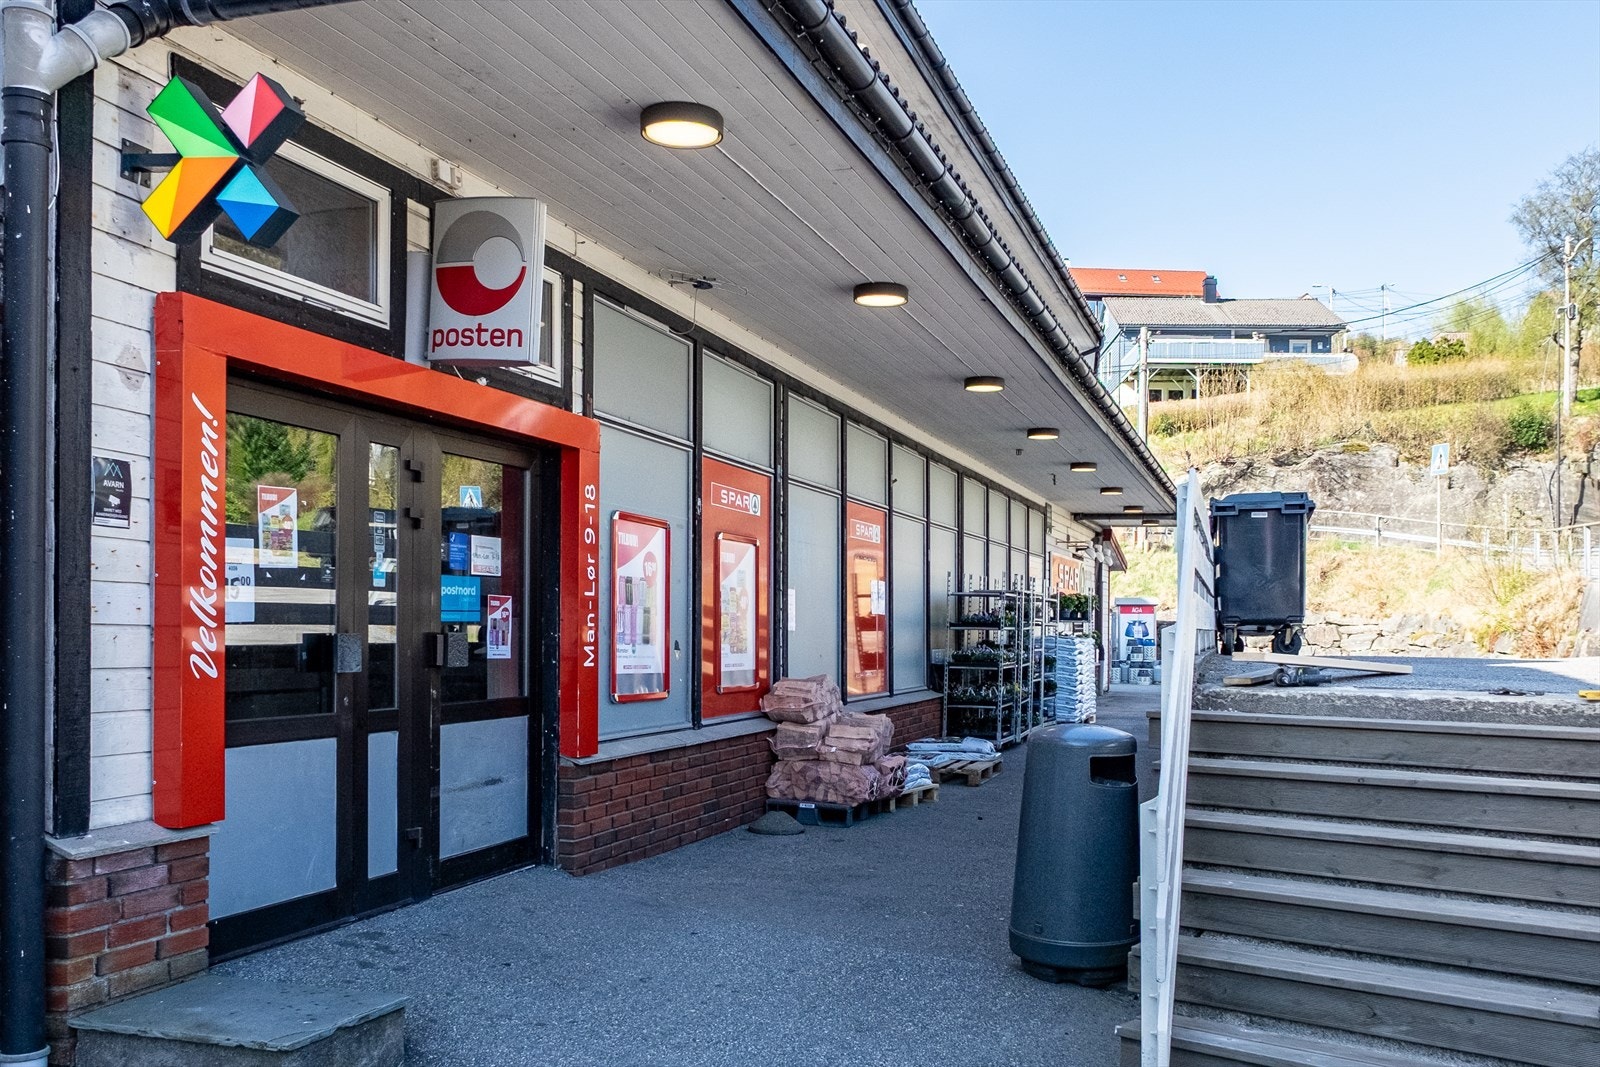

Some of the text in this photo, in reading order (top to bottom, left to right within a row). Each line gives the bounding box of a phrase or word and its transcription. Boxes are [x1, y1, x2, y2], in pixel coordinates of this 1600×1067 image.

[432, 322, 523, 353] posten
[103, 480, 124, 489] AVARN
[720, 489, 750, 509] SPAR
[189, 392, 219, 680] Velkommen!
[855, 523, 873, 538] SPAR
[583, 484, 596, 667] Man-Lør 9-18
[1057, 564, 1079, 594] SPAR
[441, 585, 477, 597] postnord
